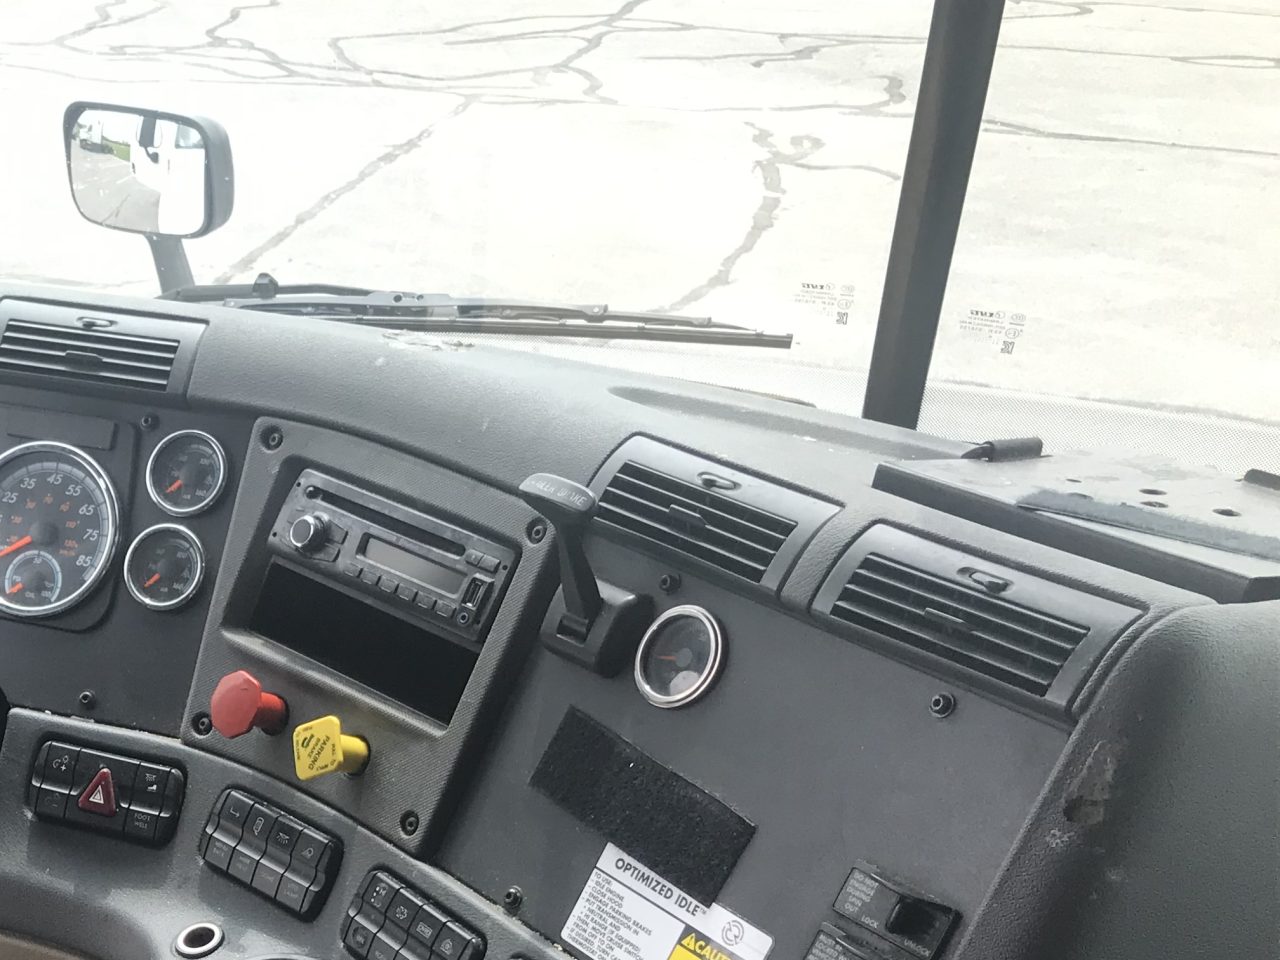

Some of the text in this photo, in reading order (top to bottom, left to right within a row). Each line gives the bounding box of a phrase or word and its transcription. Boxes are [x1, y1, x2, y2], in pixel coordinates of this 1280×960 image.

[20, 477, 37, 489] 35
[46, 473, 64, 485] 45
[65, 484, 83, 496] 55
[2, 491, 19, 504] 25
[78, 503, 96, 516] 65
[82, 529, 100, 541] 75
[75, 555, 93, 567] 85
[308, 735, 331, 771] PARKING
[134, 812, 151, 821] FOOT
[614, 857, 675, 901] OPTIMIZED
[591, 886, 624, 909] CLOSE HOOD
[595, 880, 625, 902] IDLE ENGINE
[585, 898, 595, 907] PUT
[595, 905, 633, 931] TRANSMISSION
[588, 892, 652, 936] ENGAGE PARKING BRAKES
[844, 902, 859, 913] OUT
[587, 907, 621, 932] NEUTRAL AND
[590, 917, 608, 931] RANGE
[861, 915, 880, 929] LOCK
[573, 922, 588, 934] FROM
[588, 931, 597, 940] OFF
[591, 925, 606, 938] MOVE
[606, 935, 624, 950] CRUISE
[567, 933, 598, 957] THERMOSTAT
[596, 945, 610, 957] TURN
[902, 938, 932, 958] UNLOCK
